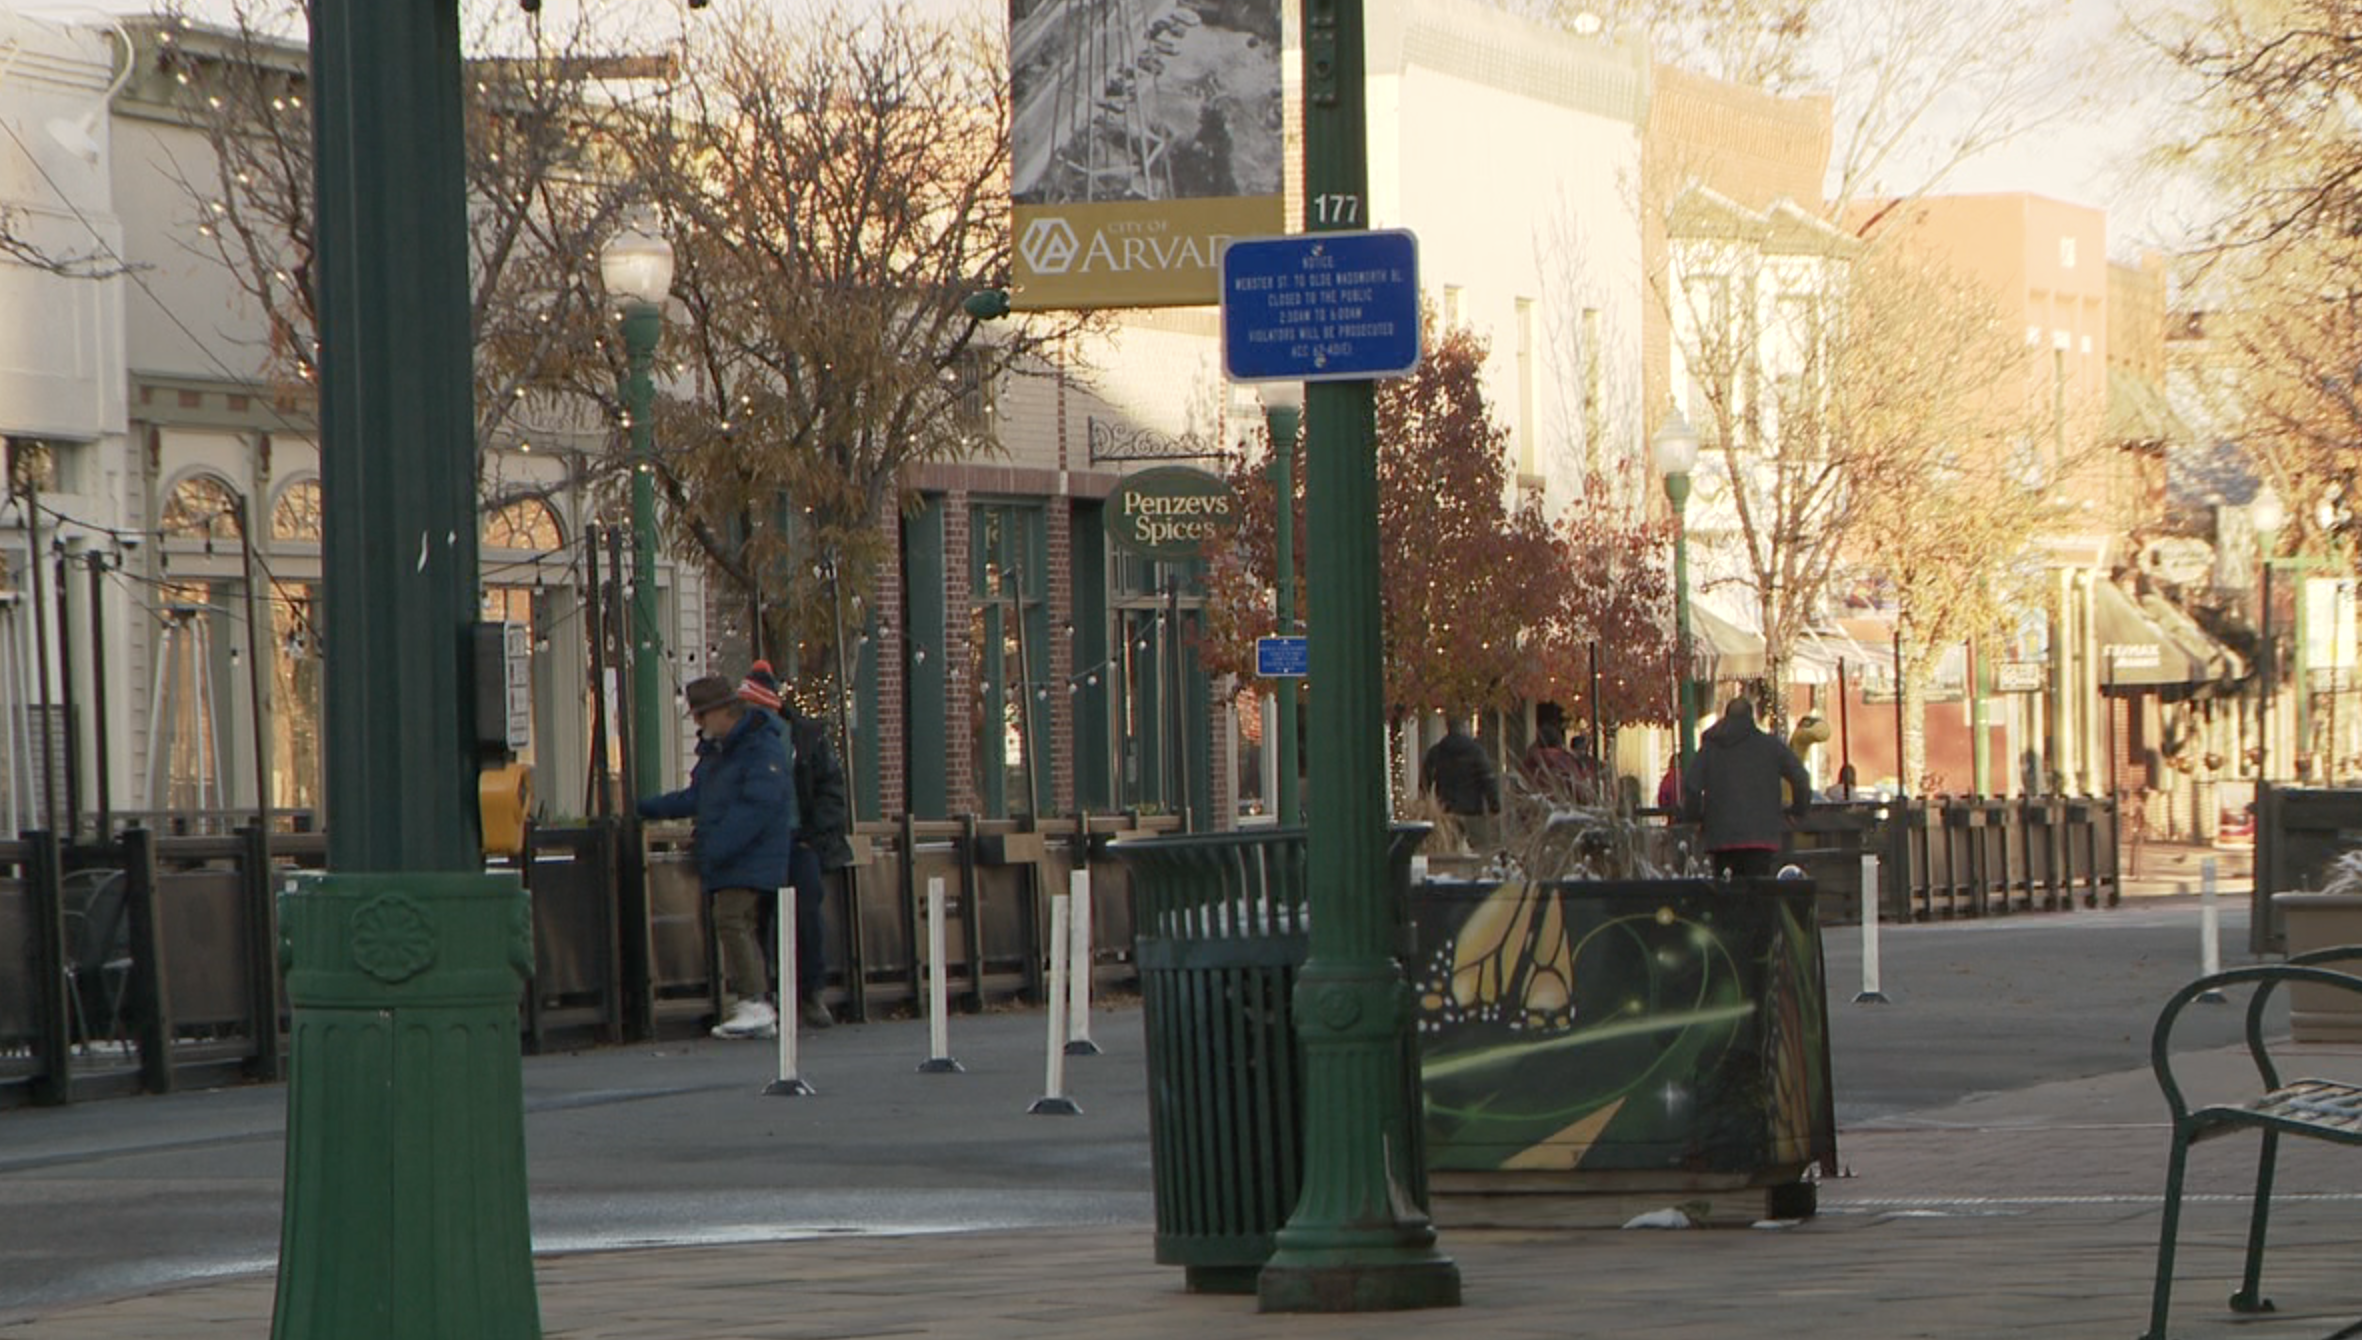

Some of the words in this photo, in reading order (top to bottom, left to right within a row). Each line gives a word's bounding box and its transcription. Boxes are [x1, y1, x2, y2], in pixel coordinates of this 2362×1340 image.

[1314, 195, 1359, 223] 177
[1108, 221, 1146, 235] CITY
[1151, 220, 1170, 233] OF
[1077, 229, 1232, 273] ARVAD
[1302, 255, 1334, 269] NOTICE
[1235, 276, 1273, 290] WEBSTER
[1294, 273, 1305, 287] TO
[1309, 272, 1331, 287] OLDE
[1336, 269, 1387, 284] WADSWORTH
[1268, 292, 1301, 307] CLOSED
[1305, 291, 1317, 305] TO
[1320, 289, 1337, 304] THE
[1340, 287, 1373, 303] PUBLIC
[1315, 308, 1326, 321] TO
[1249, 328, 1295, 342] VIOLATORS
[1299, 327, 1320, 340] WILL
[1323, 326, 1334, 339] BE
[1338, 322, 1394, 337] PROSECUTED
[1135, 515, 1216, 547] Spices
